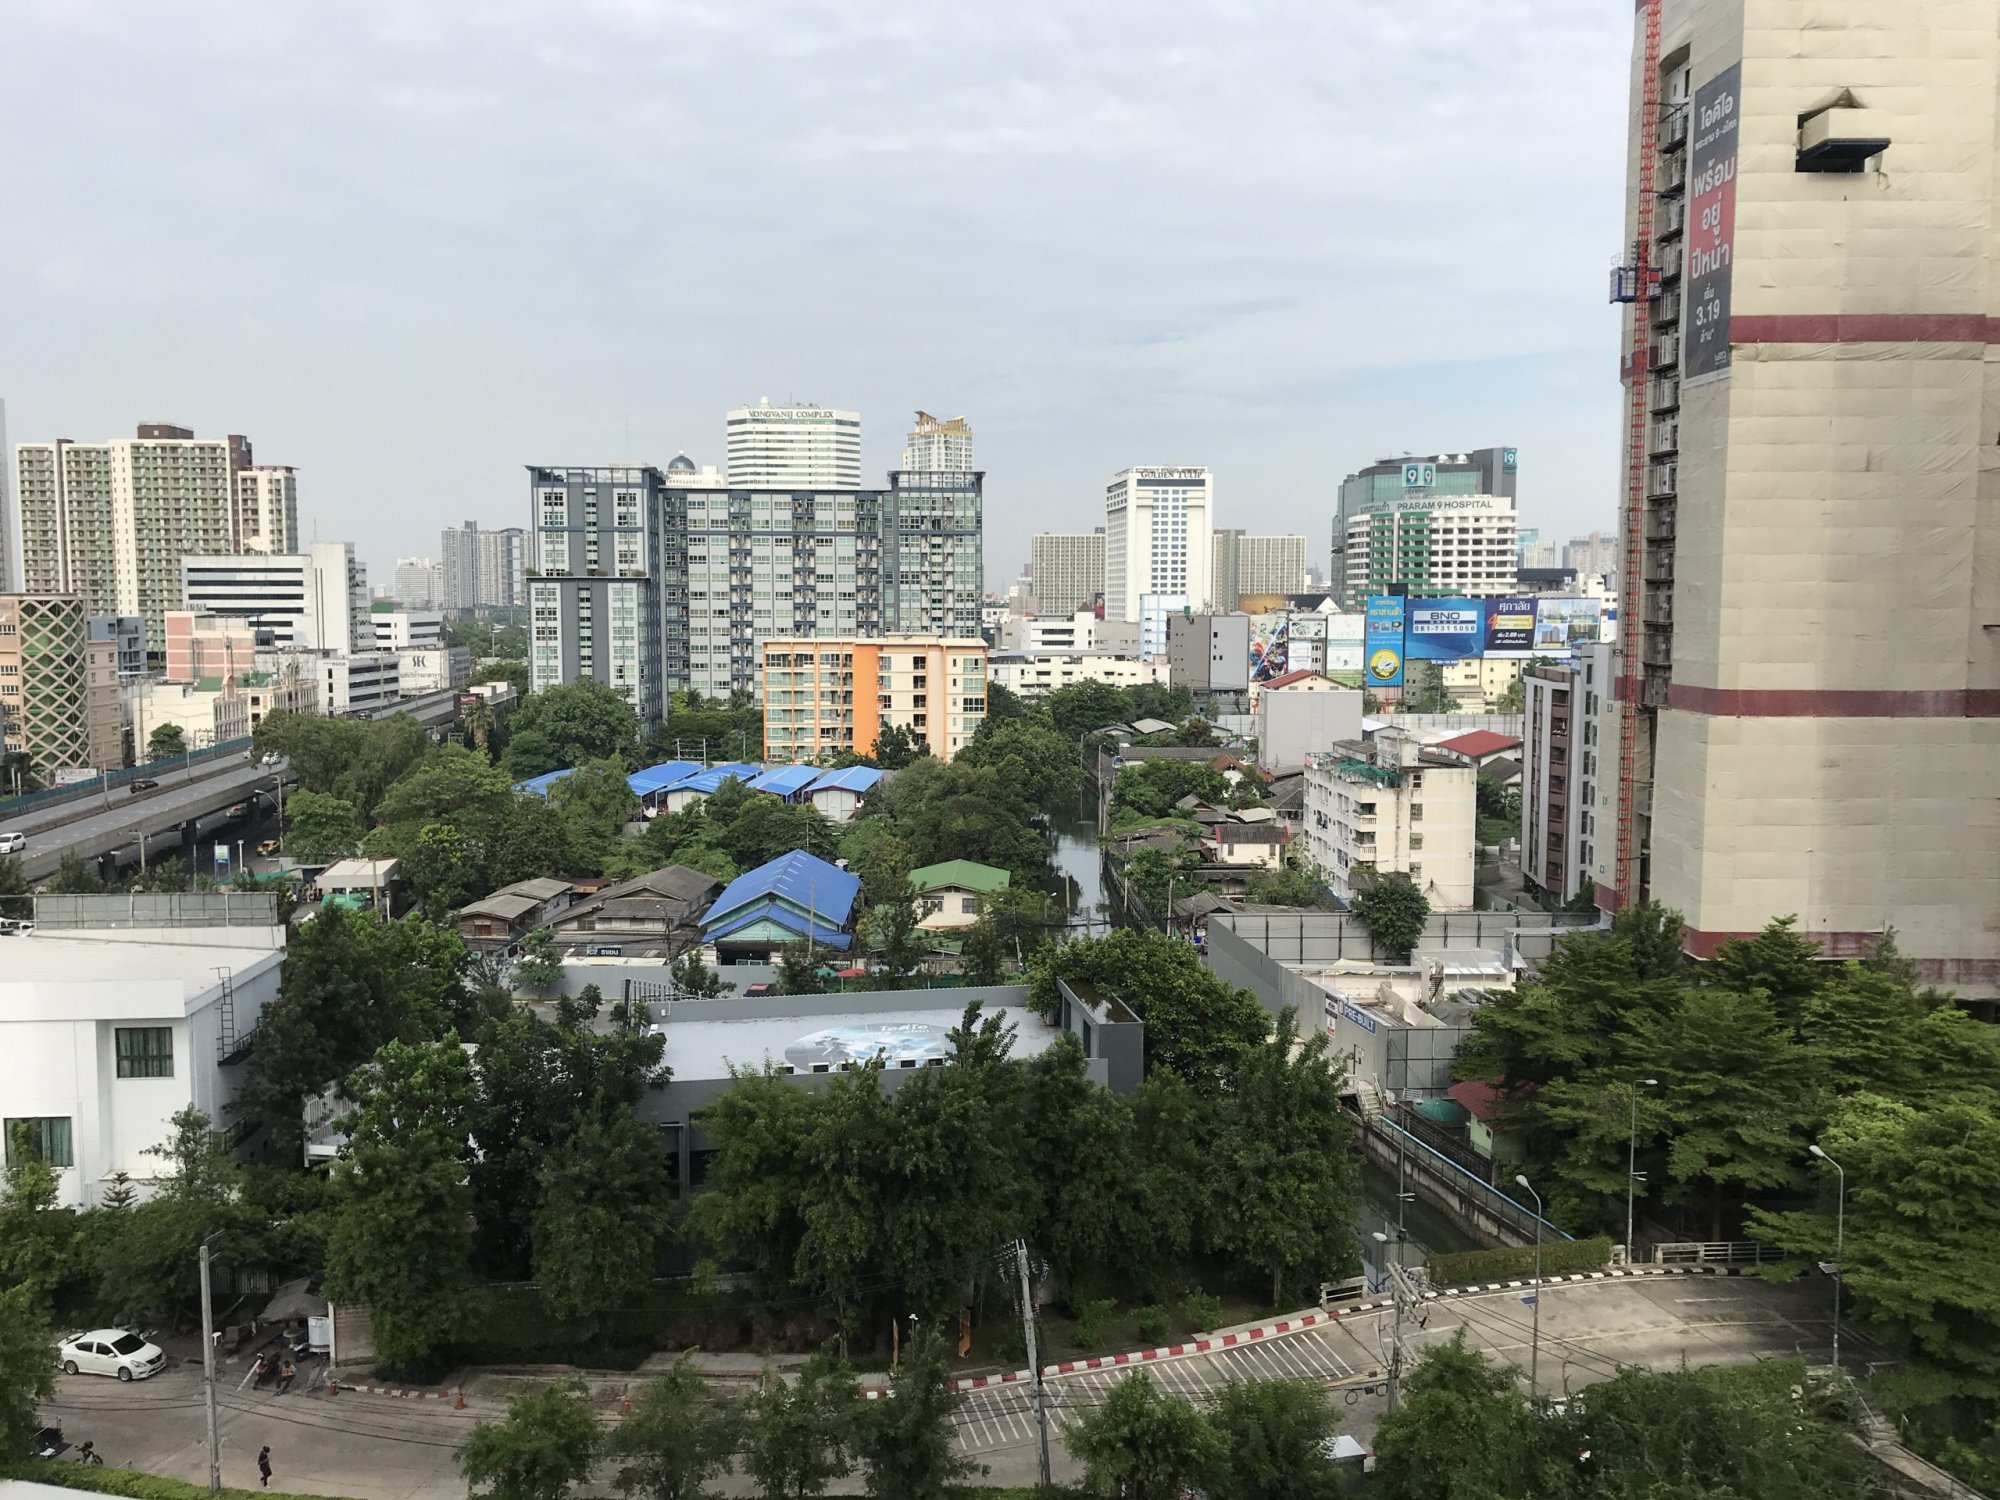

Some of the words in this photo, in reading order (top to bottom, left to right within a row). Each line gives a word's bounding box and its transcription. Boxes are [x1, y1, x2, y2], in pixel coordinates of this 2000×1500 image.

[1700, 92, 1734, 130] ไอดีโอ
[1694, 156, 1735, 198] พร้อม
[1702, 191, 1722, 235] อยู่
[1691, 236, 1730, 279] ปีหน้า
[1696, 298, 1720, 326] 3.19
[748, 411, 793, 419] VONGVANIJ
[1407, 470, 1417, 483] 9
[1425, 470, 1432, 483] 9
[1397, 502, 1435, 510] PRARAM
[1444, 500, 1493, 509] HOSPITAL
[1499, 601, 1531, 612] ศุภาลัย
[1487, 613, 1498, 630] 4
[412, 655, 426, 667] SEC
[1344, 1006, 1374, 1031] PRE-BUILT
